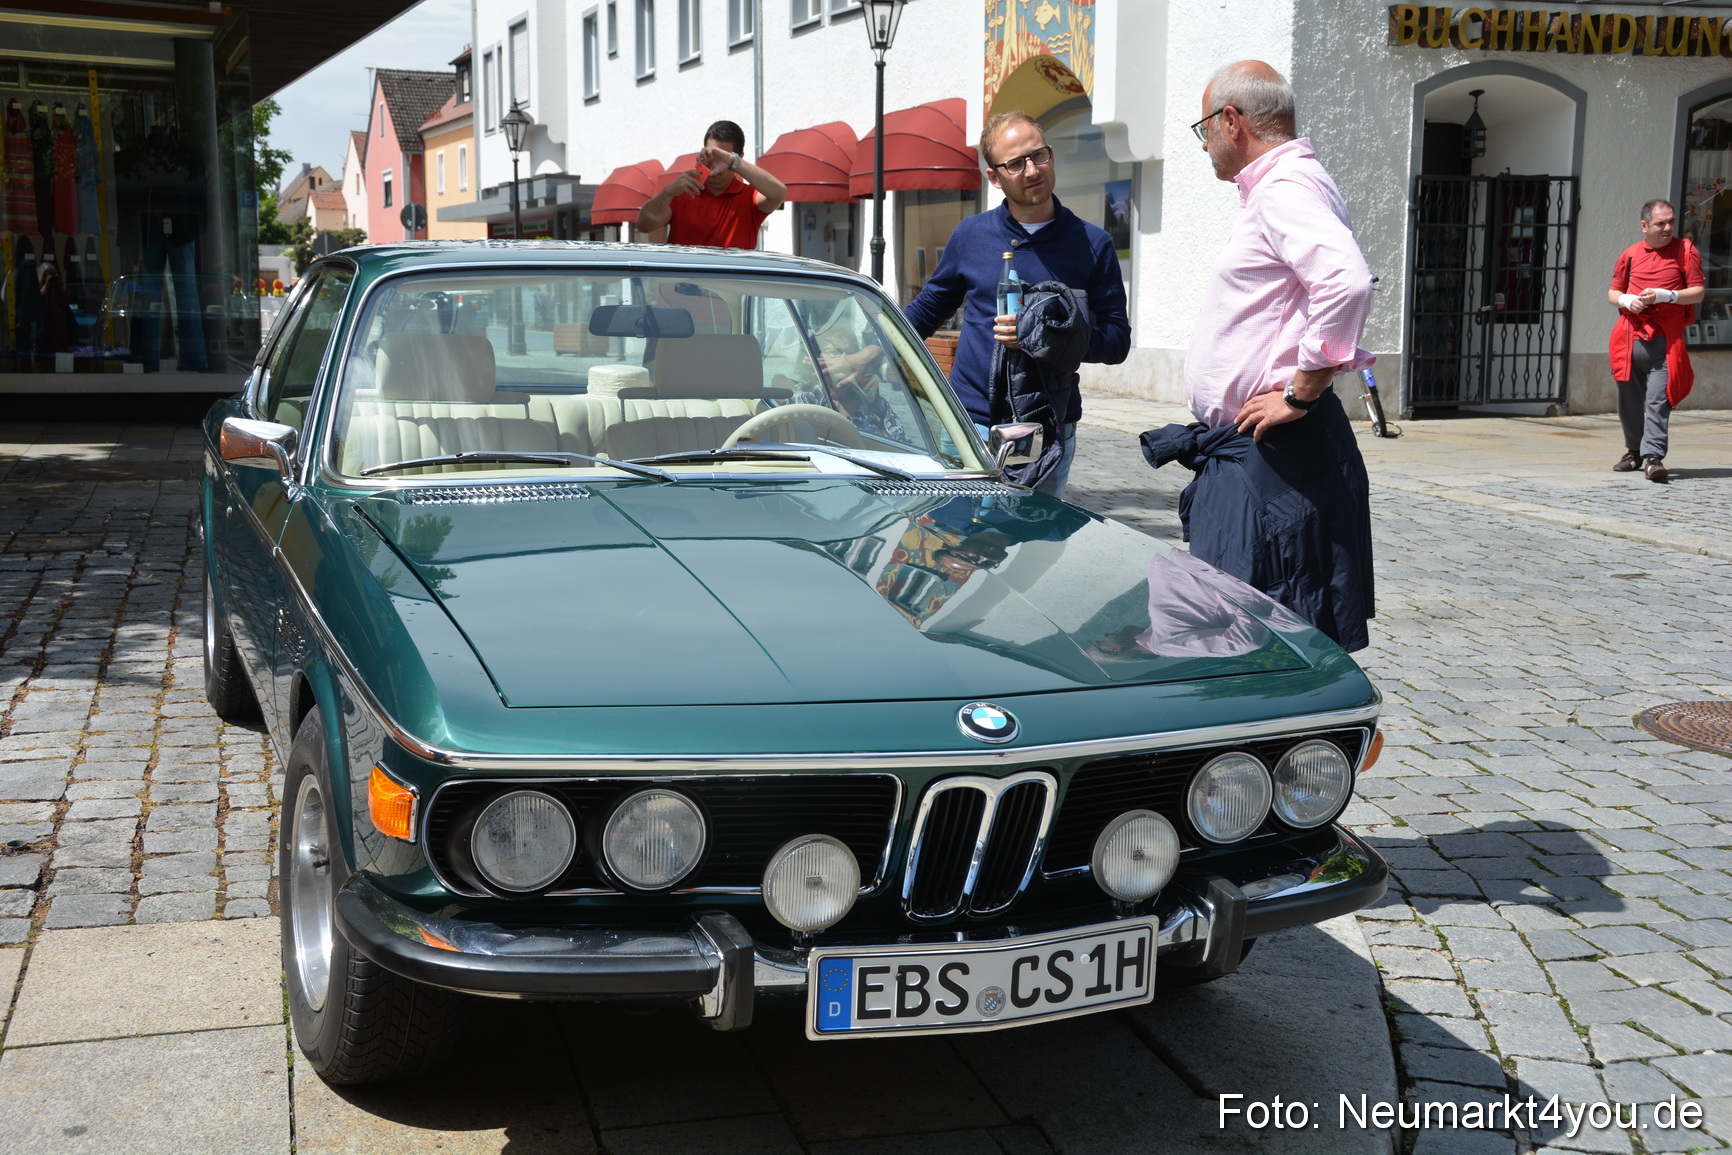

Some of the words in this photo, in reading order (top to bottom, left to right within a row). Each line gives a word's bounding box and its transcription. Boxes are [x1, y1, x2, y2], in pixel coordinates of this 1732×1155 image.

[1392, 4, 1732, 57] BUCHHANDLUN
[244, 193, 254, 206] P
[963, 703, 1005, 715] BMW
[856, 962, 970, 1020] EBS
[829, 1002, 841, 1017] D
